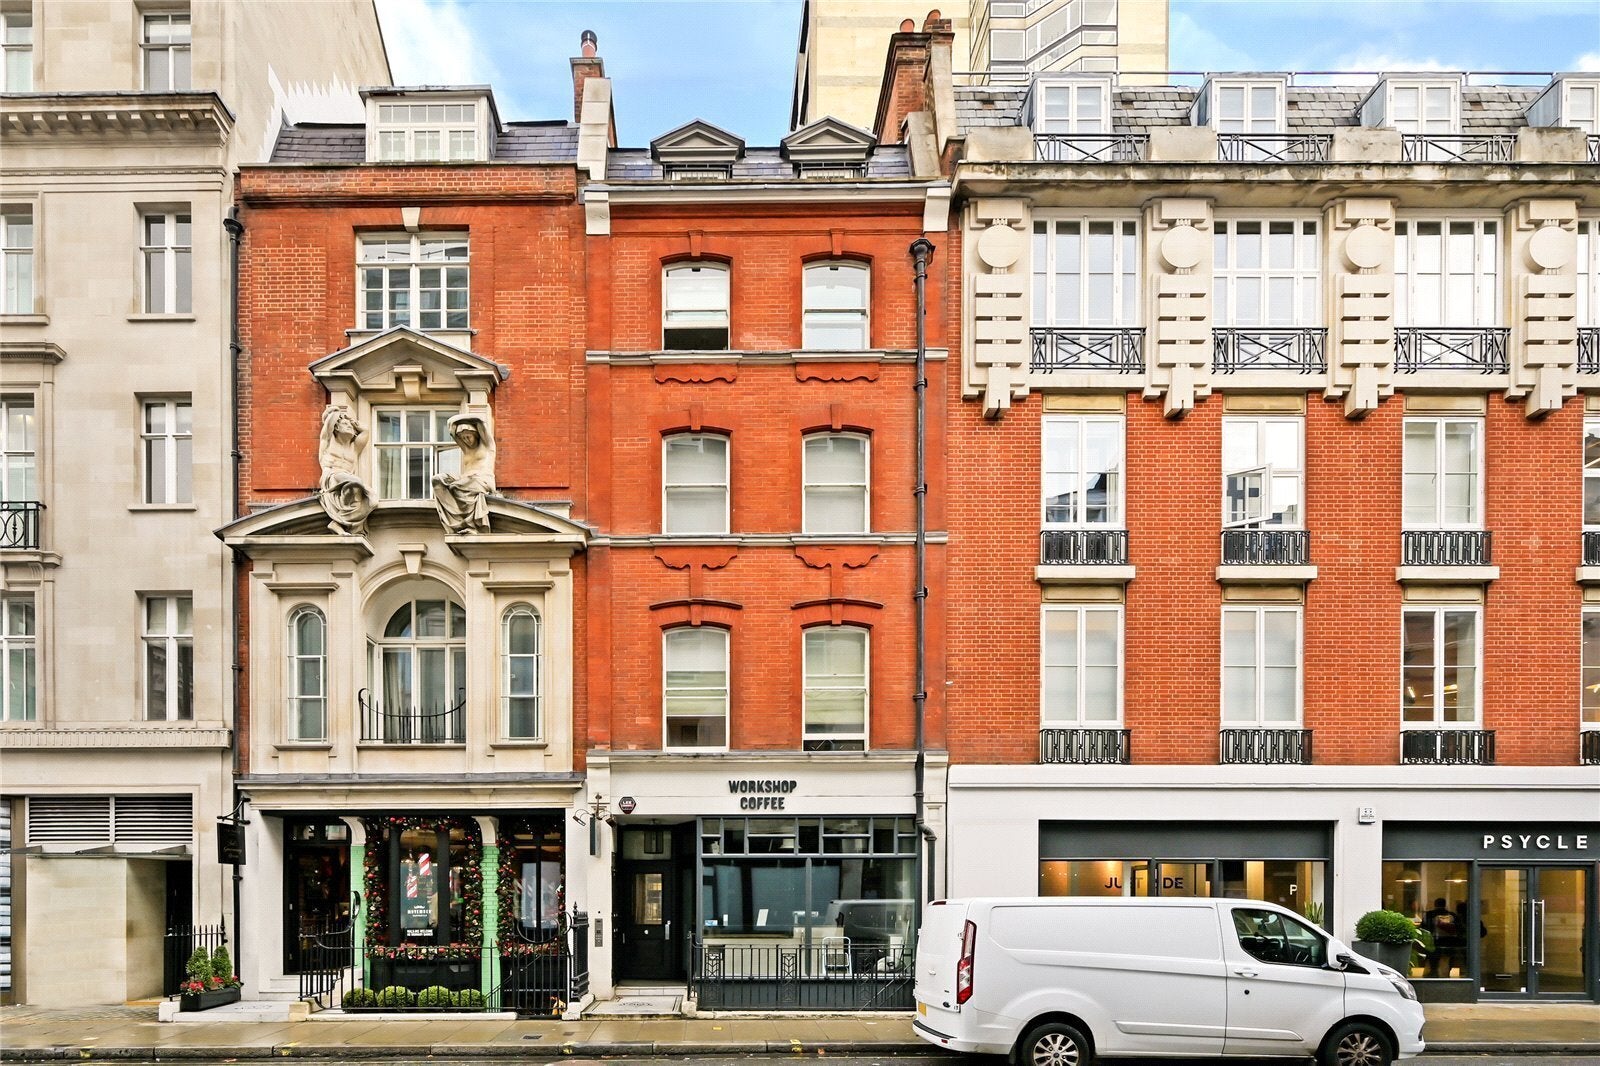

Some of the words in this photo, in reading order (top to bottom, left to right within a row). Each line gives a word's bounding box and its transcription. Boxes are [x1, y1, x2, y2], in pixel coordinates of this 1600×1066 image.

[728, 780, 797, 794] WORKSHOP
[740, 796, 785, 810] COFFEE
[1483, 834, 1588, 849] PSYCLE
[1104, 877, 1143, 889] JUT
